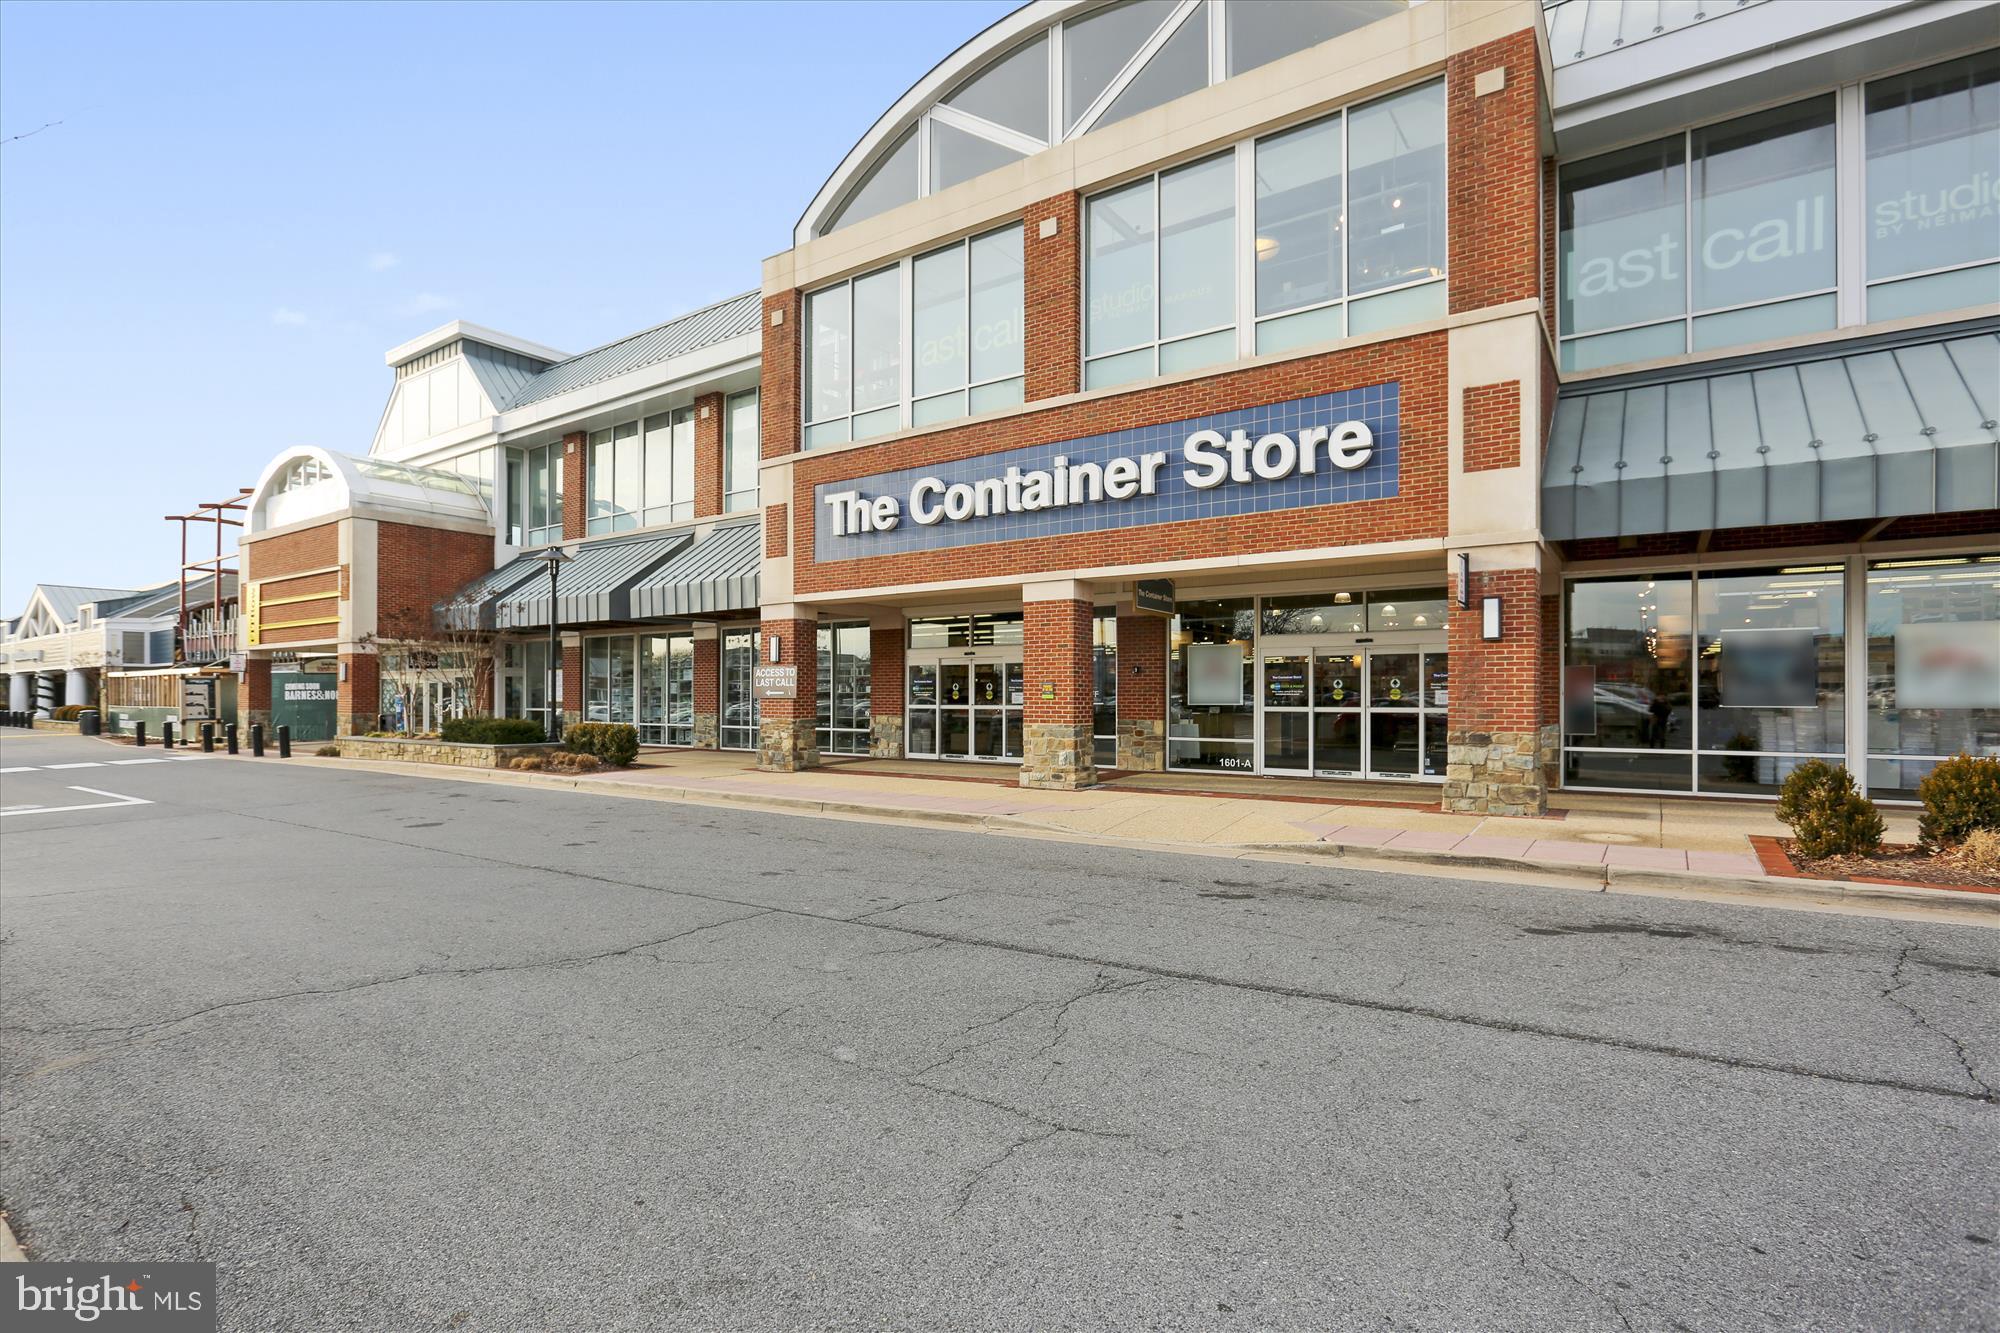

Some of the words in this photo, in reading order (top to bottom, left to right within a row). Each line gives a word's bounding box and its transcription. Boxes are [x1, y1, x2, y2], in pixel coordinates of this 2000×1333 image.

[1702, 195, 1825, 270] call
[1876, 223, 1904, 240] BY
[824, 491, 900, 537] The
[909, 451, 1167, 526] Container
[1183, 420, 1374, 489] Store
[755, 668, 785, 678] ACCESS
[785, 667, 796, 677] TO
[755, 678, 774, 687] LAST
[775, 677, 795, 687] CALL
[1219, 758, 1252, 768] 1601-A
